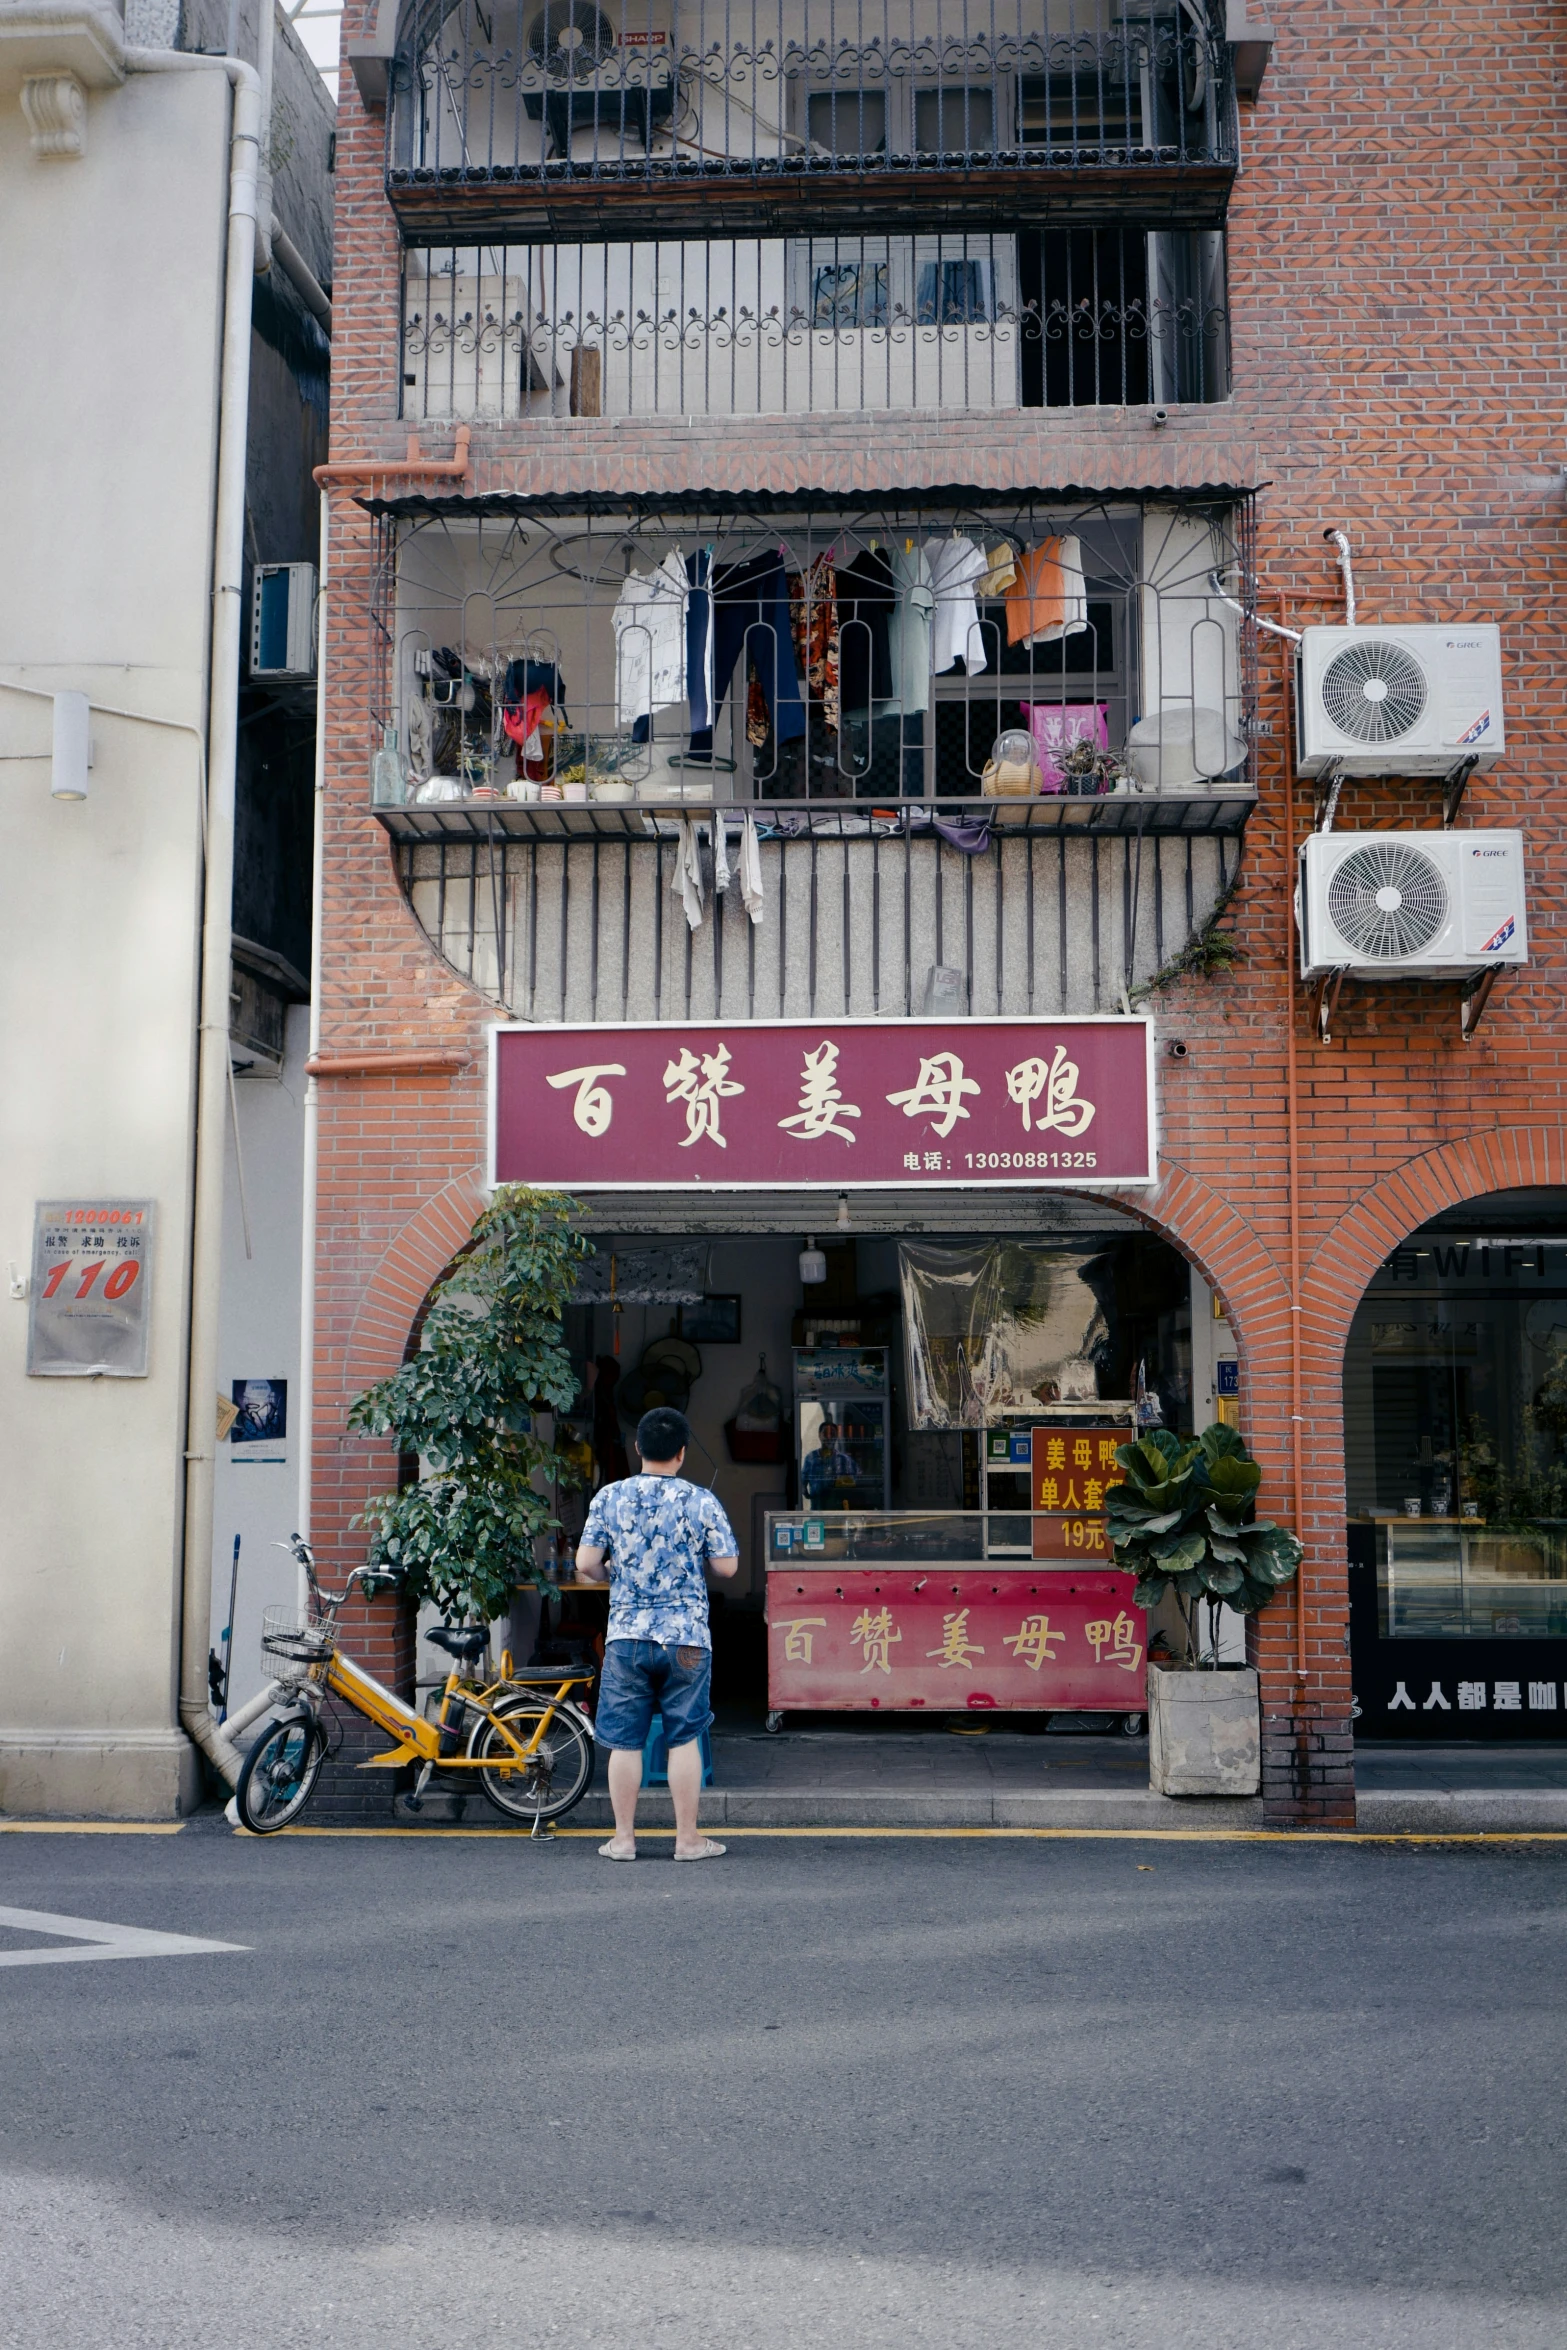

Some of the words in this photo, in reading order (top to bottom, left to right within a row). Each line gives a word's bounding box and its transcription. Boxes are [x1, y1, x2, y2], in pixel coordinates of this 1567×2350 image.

[620, 34, 664, 43] SHARP
[545, 1039, 1098, 1149] 百赞姜母鸭
[65, 1209, 143, 1225] 1200061
[45, 1236, 68, 1248] 报警
[81, 1236, 104, 1248] 求助
[117, 1236, 141, 1248] 投诉
[42, 1259, 140, 1300] 110
[1046, 1438, 1121, 1472] 姜母鸭
[1061, 1519, 1106, 1551] 19元
[770, 1606, 1144, 1676] 百赞姜母鸭
[1387, 1681, 1567, 1710] 人人都是咖
